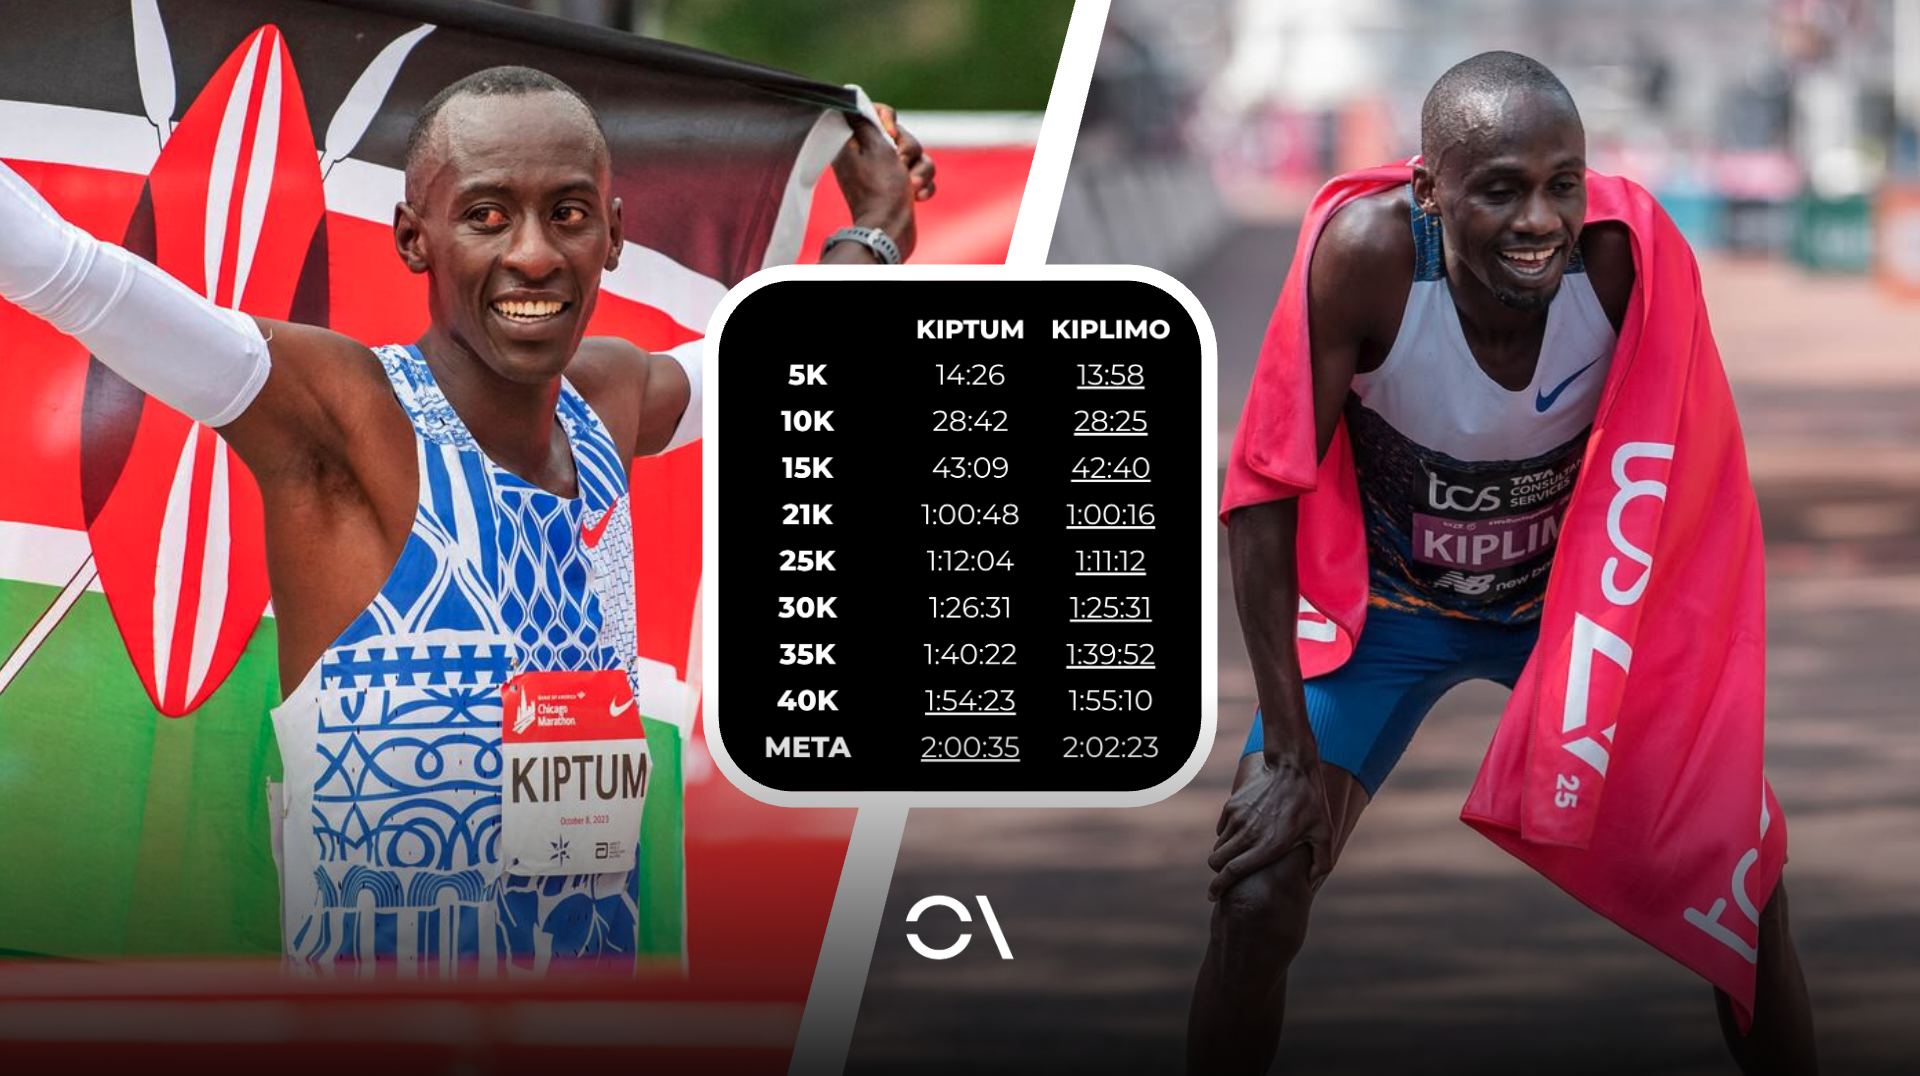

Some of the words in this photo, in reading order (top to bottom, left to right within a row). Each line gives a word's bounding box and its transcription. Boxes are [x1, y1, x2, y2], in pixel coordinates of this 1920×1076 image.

[1428, 471, 1501, 512] tcs
[1509, 468, 1555, 486] TATA
[1509, 476, 1571, 508] SERVICES
[537, 703, 569, 717] Chicago
[537, 716, 576, 727] Marathon
[512, 752, 648, 803] KIPTUM
[1554, 773, 1581, 809] 25
